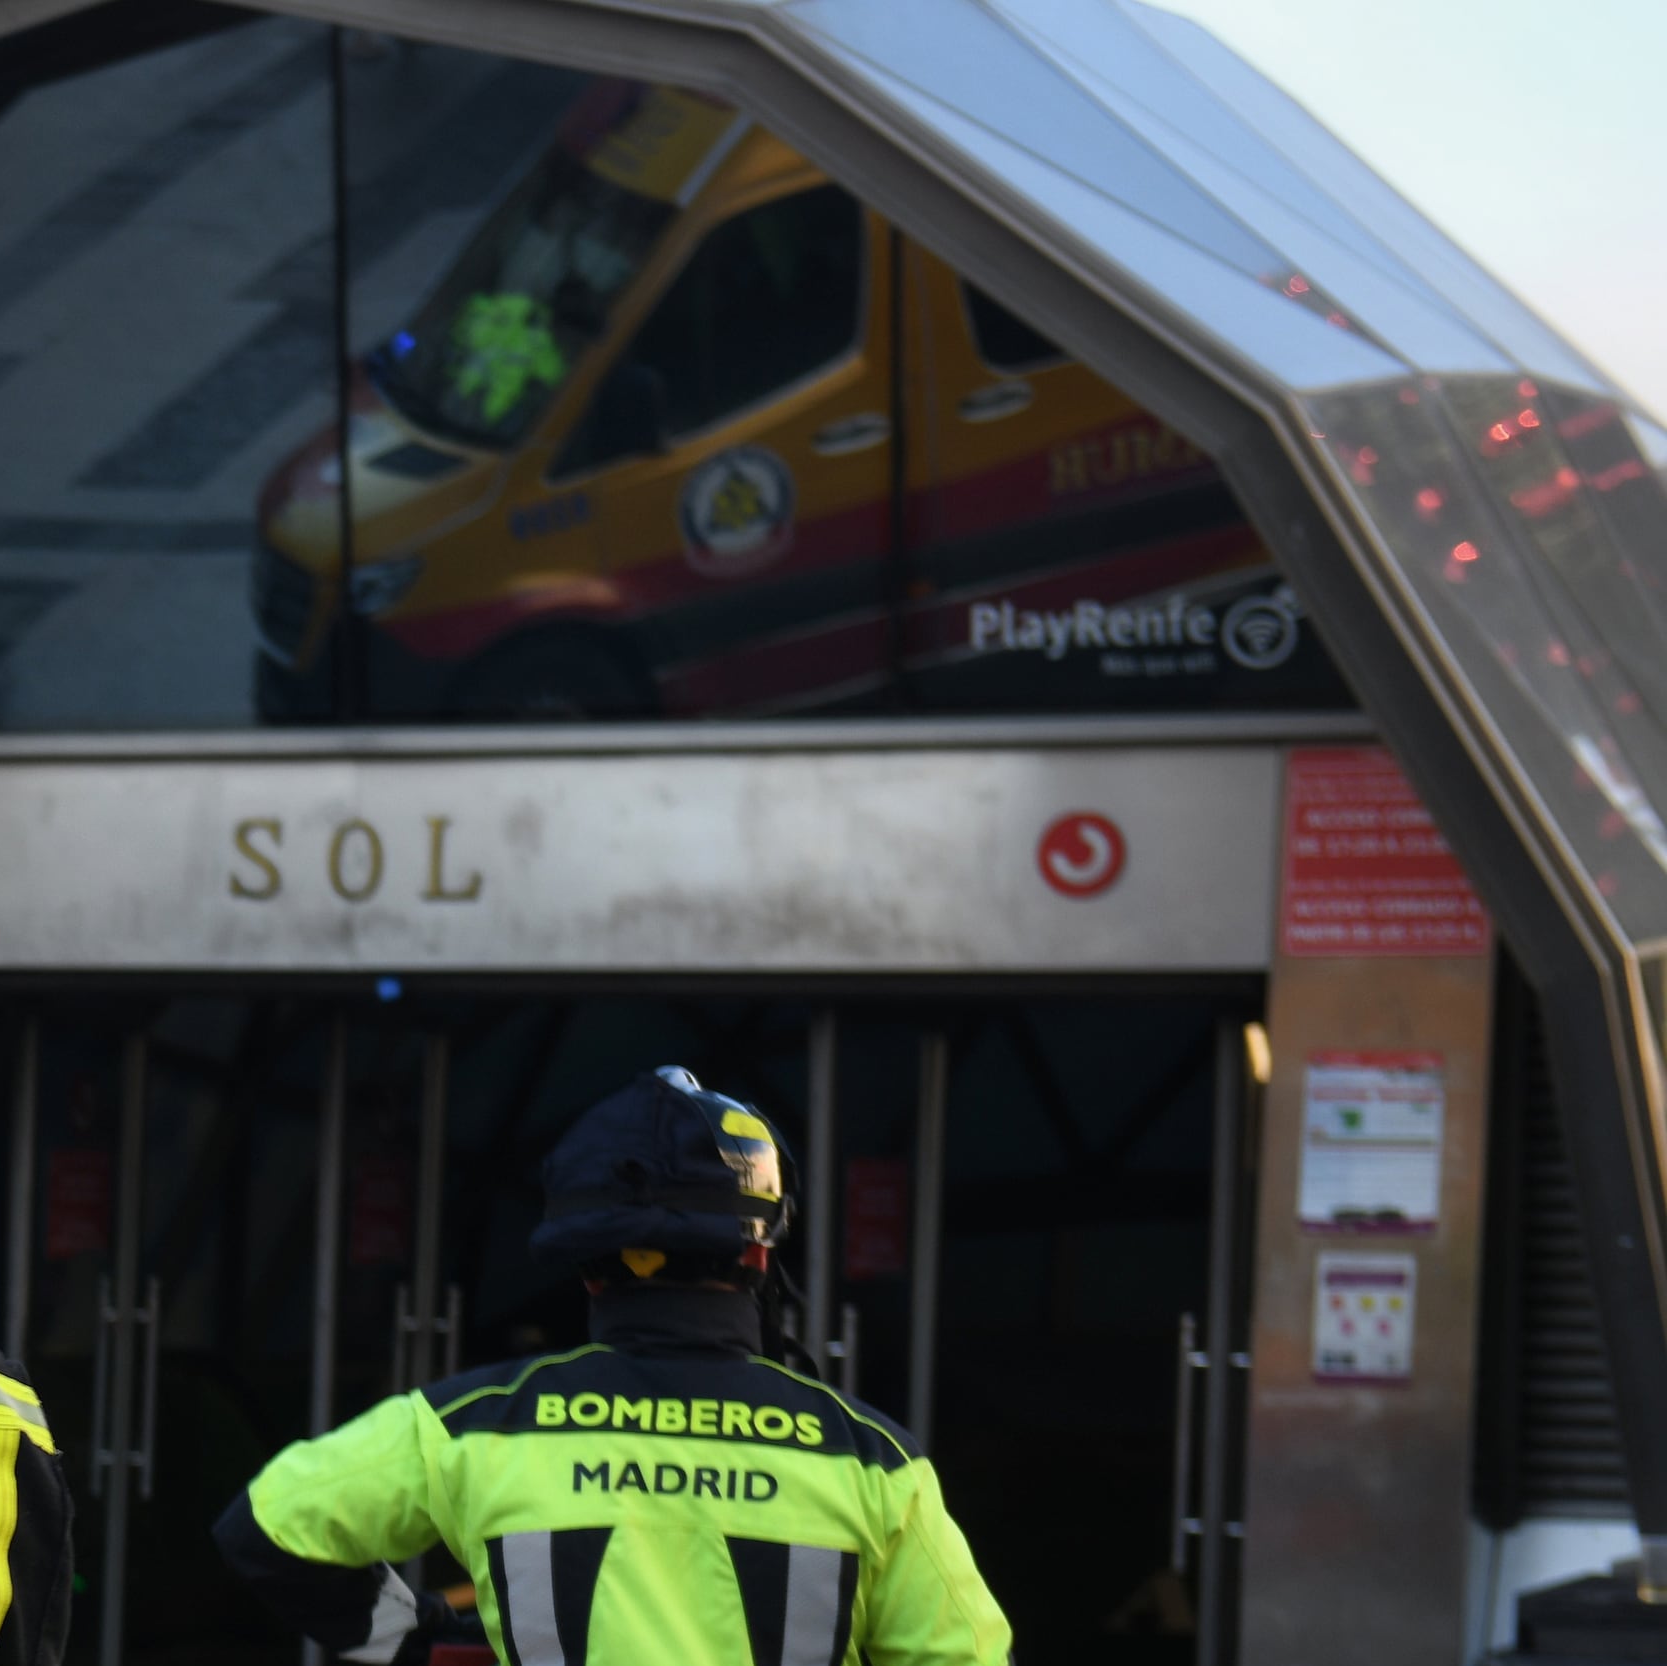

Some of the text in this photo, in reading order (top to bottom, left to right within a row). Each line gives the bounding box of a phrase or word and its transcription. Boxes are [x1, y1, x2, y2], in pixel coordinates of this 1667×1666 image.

[970, 594, 1215, 661] PlayRenfe
[228, 815, 483, 903] SOL
[536, 1393, 823, 1448] BOMBEROS
[573, 1460, 779, 1503] MADRID
